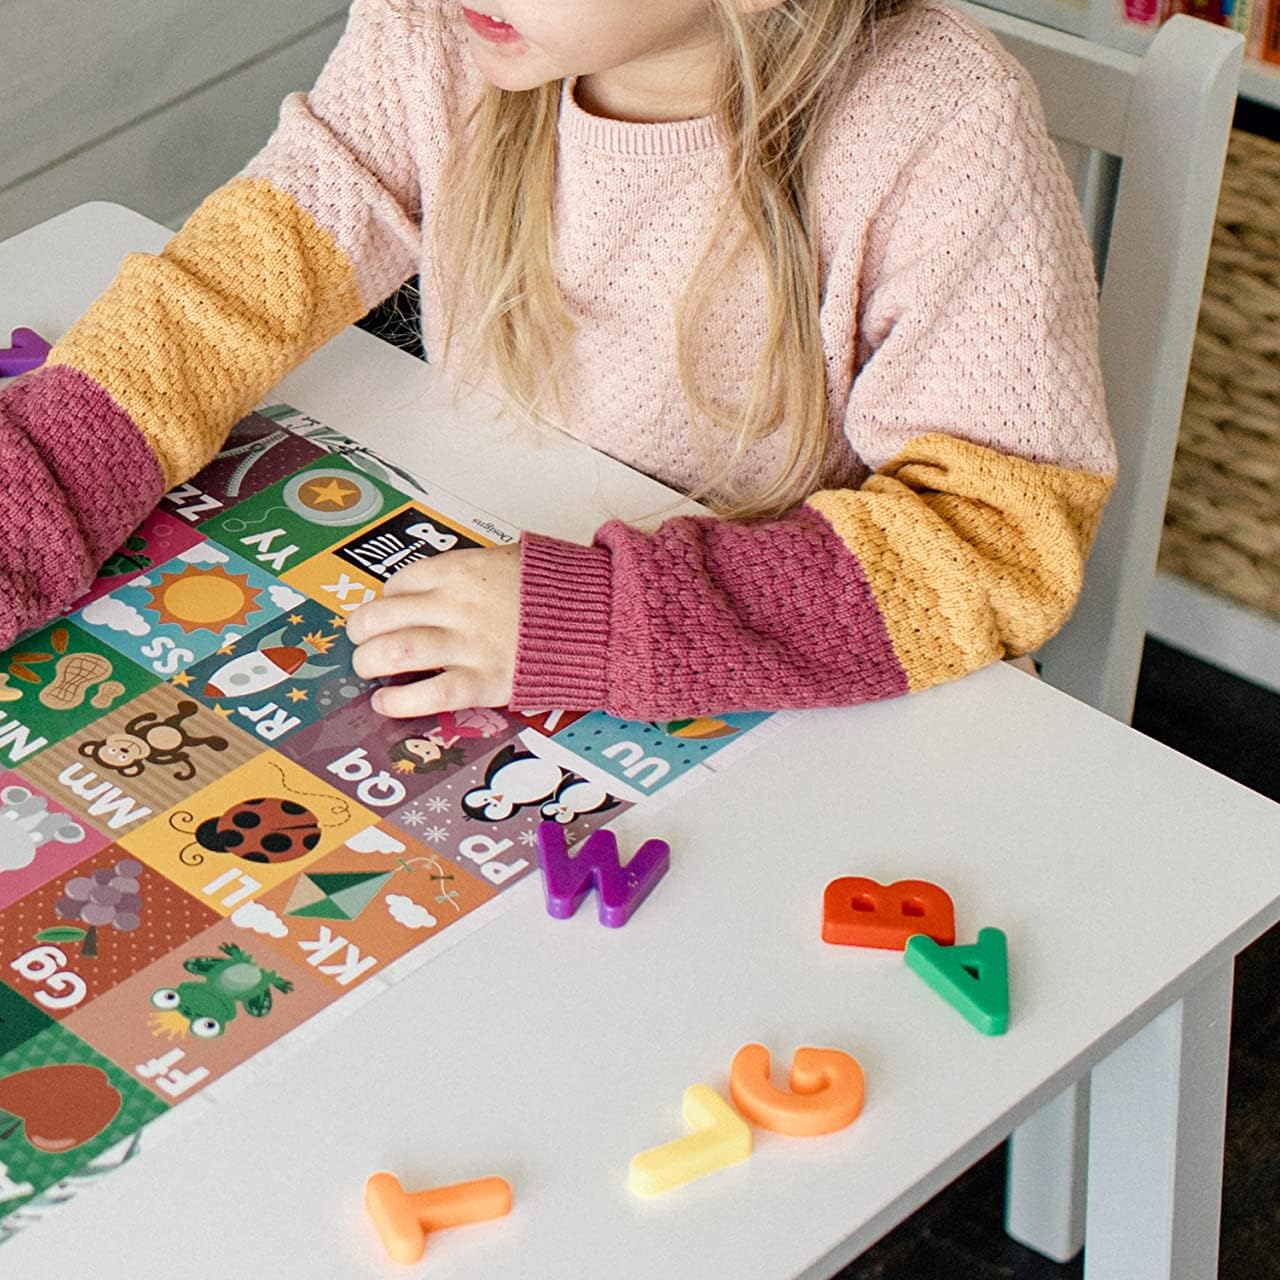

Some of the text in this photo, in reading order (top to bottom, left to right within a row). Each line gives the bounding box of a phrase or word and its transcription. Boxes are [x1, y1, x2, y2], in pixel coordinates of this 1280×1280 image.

[165, 483, 224, 522] Zz
[471, 518, 513, 544] Designs
[239, 527, 300, 571] Yy
[141, 636, 195, 676] Ss
[237, 700, 304, 743] Rr
[326, 747, 408, 808] Qq
[601, 740, 671, 789] Uu
[57, 761, 153, 830] Mm
[200, 866, 264, 908] Ll
[458, 832, 530, 886] Pp
[537, 820, 671, 929] W
[822, 875, 956, 951] B
[9, 946, 87, 1011] Gg
[297, 925, 380, 987] Kk
[904, 927, 1010, 1036] A
[135, 1046, 211, 1098] Ff
[729, 1042, 866, 1137] G
[365, 1171, 513, 1265] T
